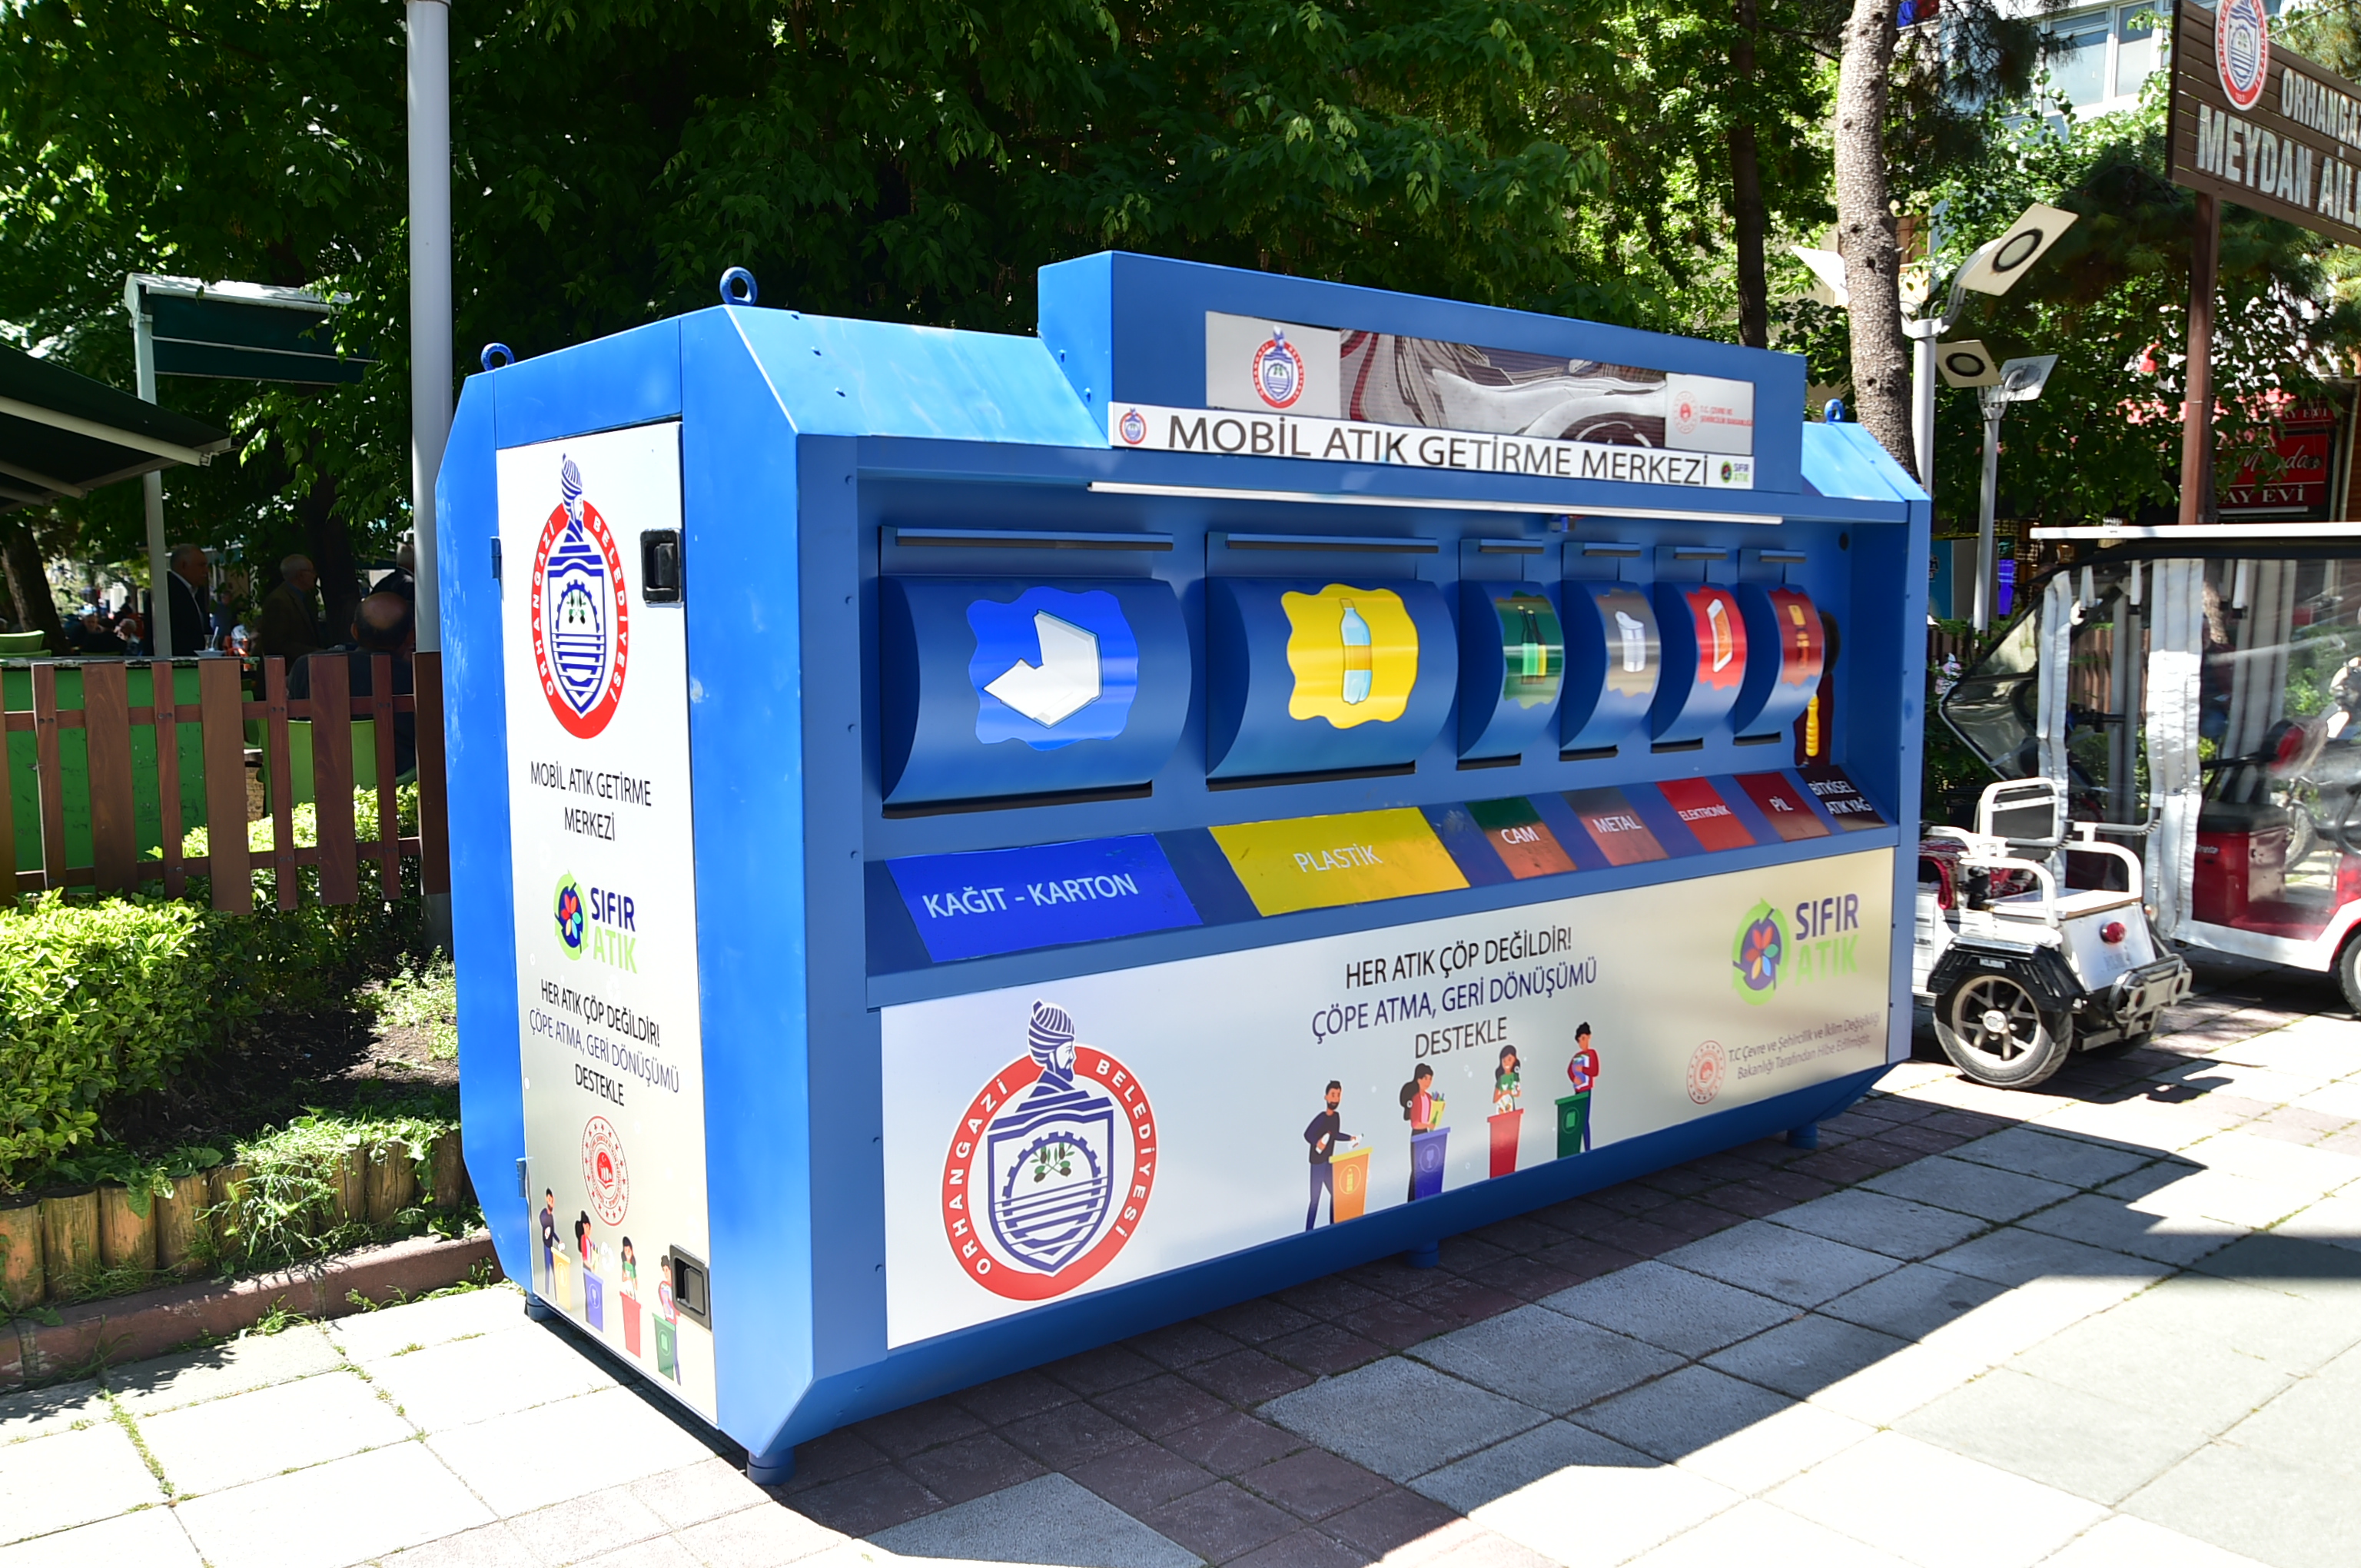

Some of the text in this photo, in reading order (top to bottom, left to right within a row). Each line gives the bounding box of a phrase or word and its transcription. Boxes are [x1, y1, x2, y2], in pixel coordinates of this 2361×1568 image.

[2281, 68, 2361, 150] ORHANGA
[2197, 104, 2312, 208] MEYDAN
[1168, 415, 1311, 457] MOBİL
[1323, 427, 1409, 463] ATIK
[1419, 435, 1572, 476] GETİRME
[1581, 450, 1708, 486] MERKEZİ
[2221, 485, 2304, 504] AY EVİ
[533, 519, 556, 696] ORHANGAZİ
[592, 515, 628, 703] BELEDİYESİ
[530, 760, 652, 807] MOBİL ATIK GETİRME
[1768, 796, 1795, 812] PİL
[1808, 779, 1857, 796] BİTKİSEL
[1825, 796, 1874, 815] ATIK YAĞ
[564, 807, 616, 842] MERKEZİ
[1500, 824, 1541, 845] CAM
[1592, 815, 1643, 834] METAL
[1678, 804, 1732, 822] ELEKTRONİK
[1293, 842, 1383, 873] PLASTİK
[590, 887, 636, 932] SIFIR
[922, 886, 1008, 919] KAĞIT
[1027, 873, 1139, 907] KARTON
[1795, 893, 1859, 941] SIFIR
[593, 925, 638, 975] ATIK
[1346, 925, 1572, 990] HER ATIK ÇÖP DEĞİLDİR!
[1795, 934, 1859, 987] ATIK
[540, 978, 661, 1048] HER ATIK ÇÖP DEĞİLDİR!
[1312, 955, 1597, 1045] ÇÖPE ATMA, GERİ DÖNÜŞÜMÜ
[529, 1008, 679, 1094] ÇÖPE ATMA, GERİ DÖNÜŞÜMÜ
[1414, 1016, 1508, 1059] DESTEKLE
[1742, 1043, 1765, 1061] Çevre
[1767, 1041, 1778, 1052] ve
[1814, 1028, 1825, 1040] ve
[575, 1064, 625, 1107] DESTEKLE
[1095, 1058, 1156, 1238] BELEDİYESİ
[948, 1078, 1009, 1276] ORHANGAZİ
